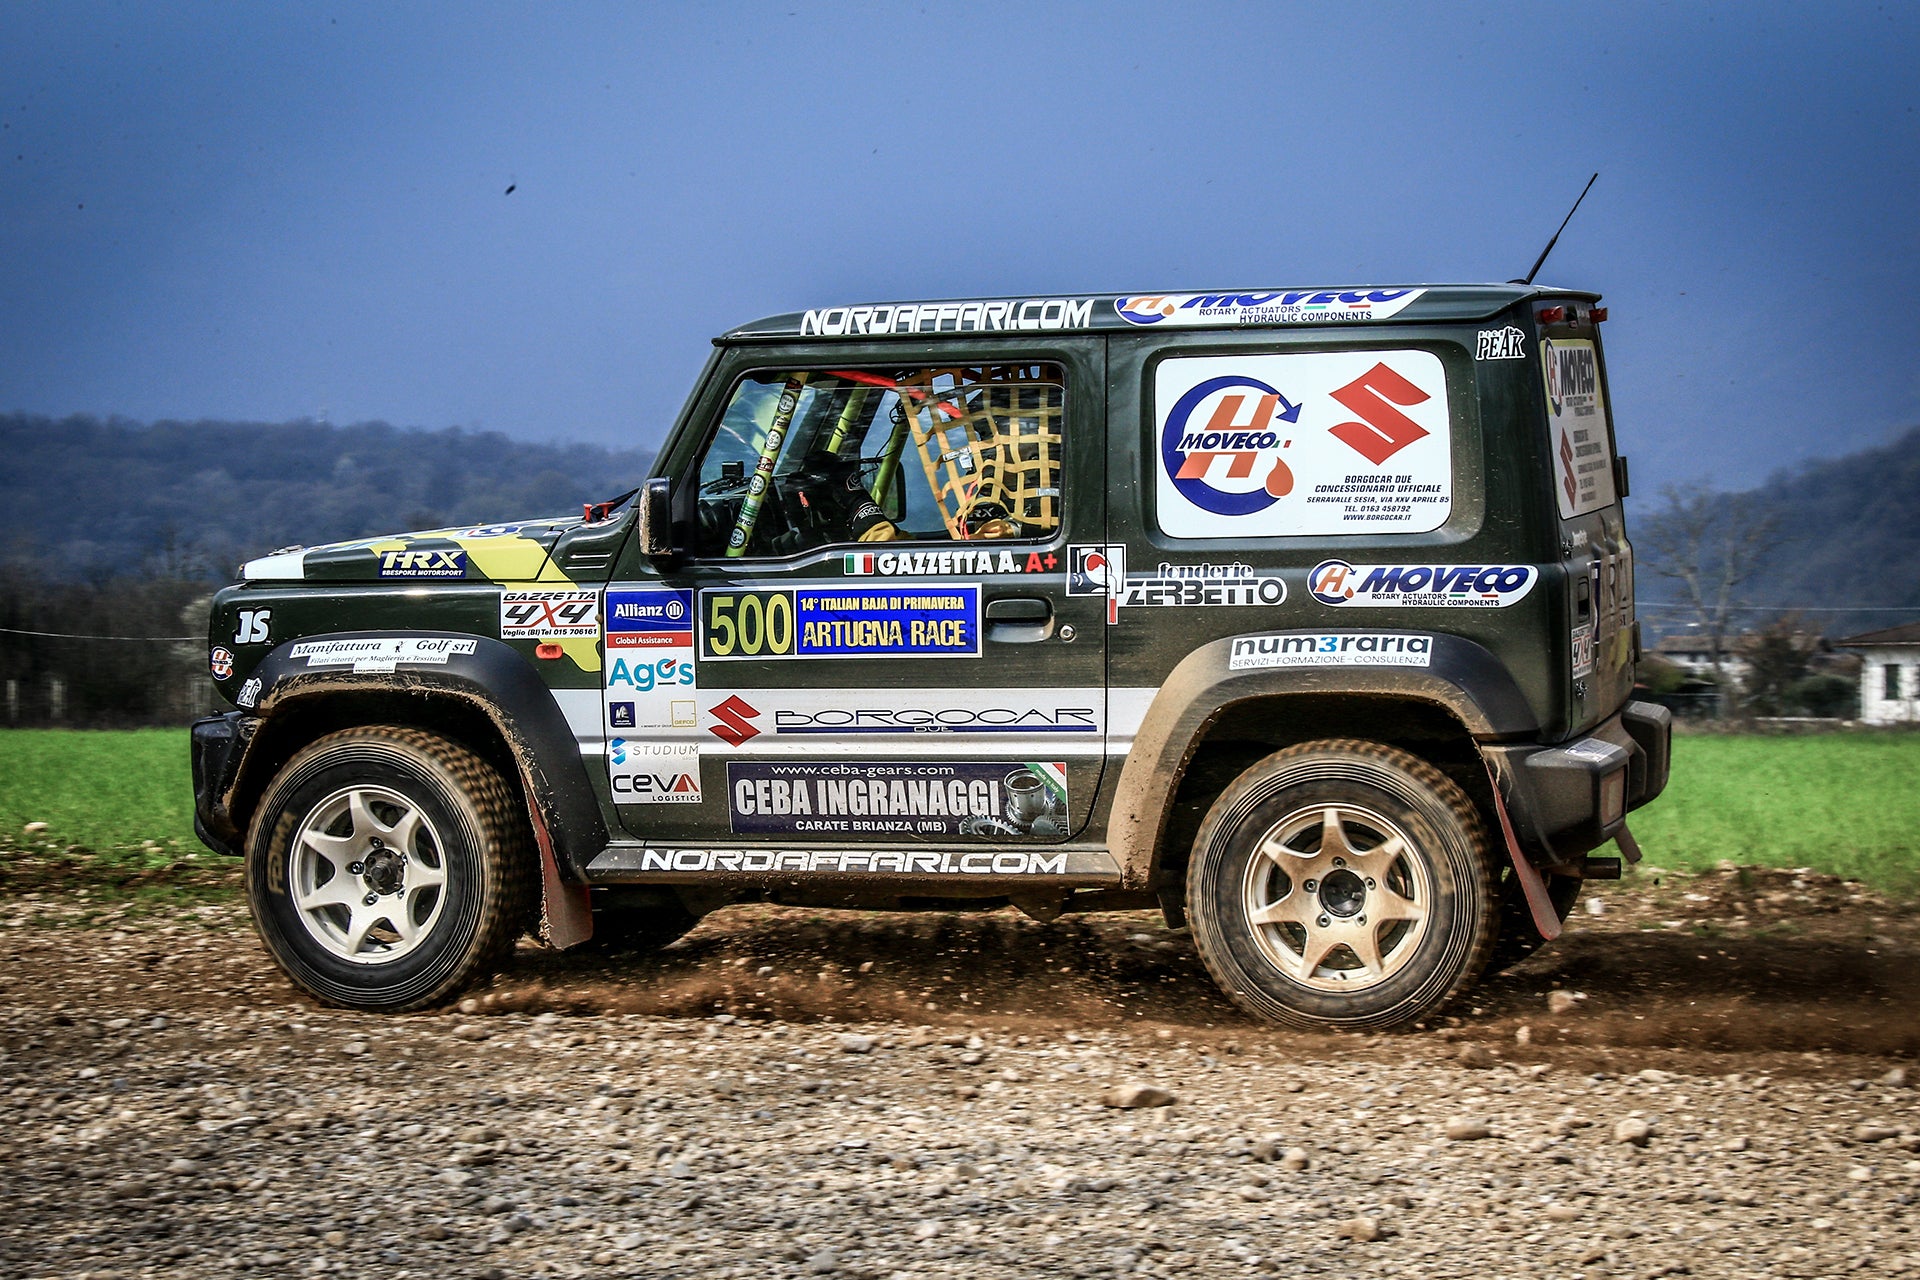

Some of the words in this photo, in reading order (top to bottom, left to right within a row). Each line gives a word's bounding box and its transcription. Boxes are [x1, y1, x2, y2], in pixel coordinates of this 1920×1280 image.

[799, 299, 1095, 337] NORDAFFARI.COM
[1199, 306, 1238, 316] ROTARY
[1240, 305, 1301, 315] ACTUATORS
[1239, 313, 1300, 323] HYDRAULIC
[1301, 311, 1372, 321] COMPONENTS
[1477, 327, 1525, 359] PEAK
[1179, 432, 1277, 450] MOVECO
[1344, 475, 1393, 484] BORGOCAR
[1394, 475, 1413, 484] DUE
[1314, 484, 1395, 493] CONCESSIONARIO
[1397, 484, 1442, 493] UFFICIALE
[1353, 496, 1378, 504] SESIA,
[382, 551, 464, 569] HRX
[877, 550, 994, 576] GAZZETTA
[996, 550, 1022, 574] A.
[1025, 551, 1058, 573] A+
[1159, 562, 1255, 578] fonderie
[1356, 567, 1530, 593] MOVECO
[503, 591, 597, 601] GAZZETTA
[1126, 579, 1284, 605] ZERBETTO
[614, 603, 664, 618] Allianz
[820, 597, 860, 611] ITALIAN
[861, 597, 889, 611] BAJA
[889, 597, 902, 610] DI
[903, 596, 966, 610] PRIMAVERA
[235, 610, 272, 644] JS
[502, 629, 526, 637] Veglio
[541, 628, 552, 636] Tel
[709, 593, 793, 656] 500
[615, 636, 637, 645] Global
[637, 636, 673, 645] Assistance
[803, 620, 904, 647] ARTUGNA
[910, 620, 967, 647] RACE
[293, 641, 382, 656] Manifattura
[415, 639, 452, 654] Golf
[452, 639, 475, 653] srl
[1233, 636, 1429, 655] num3raria
[310, 656, 330, 664] Filati
[330, 655, 355, 663] ritorti
[354, 655, 367, 663] per
[368, 654, 405, 663] Maglieria
[412, 654, 446, 662] Tessitura
[608, 657, 695, 692] Agos
[775, 708, 1095, 726] BORGOCAR
[633, 745, 699, 756] STUDIUM
[771, 764, 956, 778] www.ceba-gears.com
[735, 779, 812, 816] CEBA
[816, 779, 1001, 817] INGRANAGGI
[795, 820, 850, 832] CARATE
[853, 820, 914, 832] BRIANZA
[917, 820, 948, 834] (MB)
[640, 850, 1069, 875] NORDAFFARI.COM
